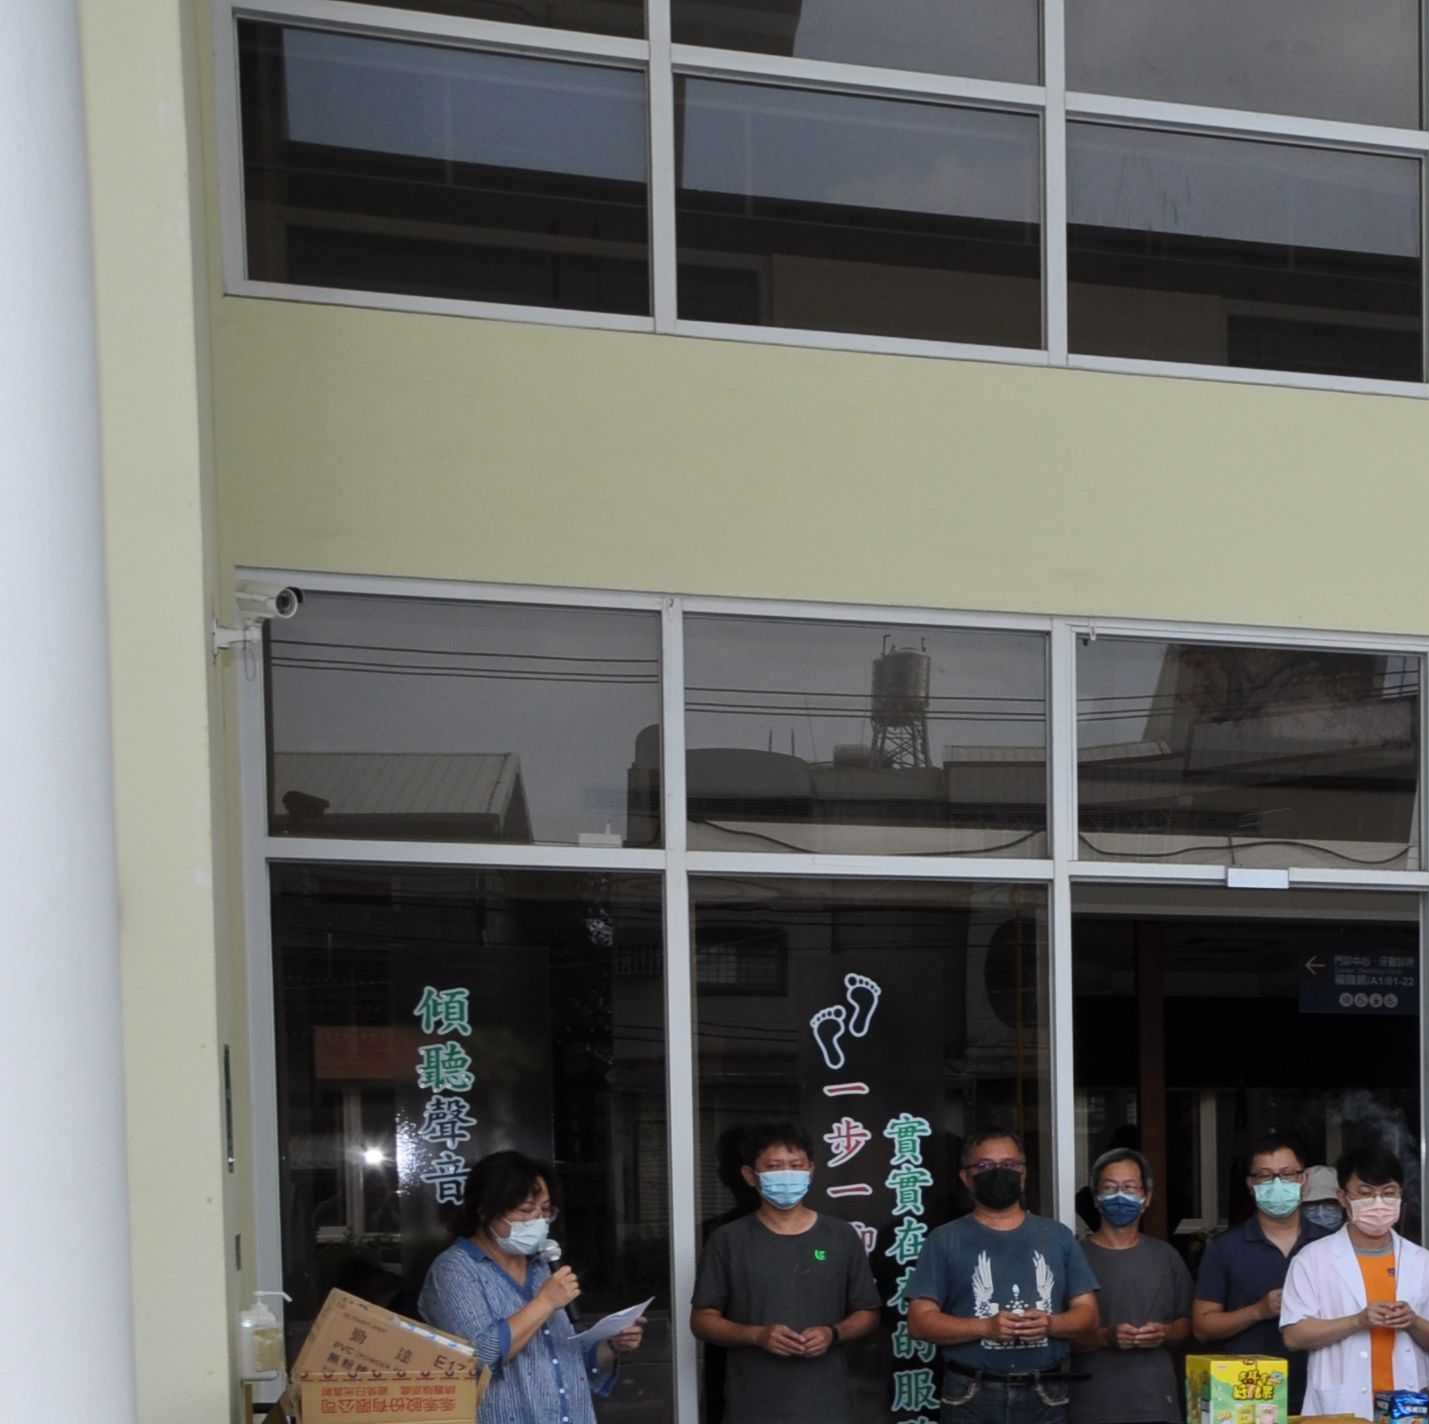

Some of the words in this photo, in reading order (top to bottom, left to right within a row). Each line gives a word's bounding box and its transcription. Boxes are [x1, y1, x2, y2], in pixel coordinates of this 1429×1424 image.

[414, 985, 477, 1206] 傾聽聲音
[333, 1341, 355, 1355] PVC
[320, 1396, 457, 1414] 乖乖股份有限公司
